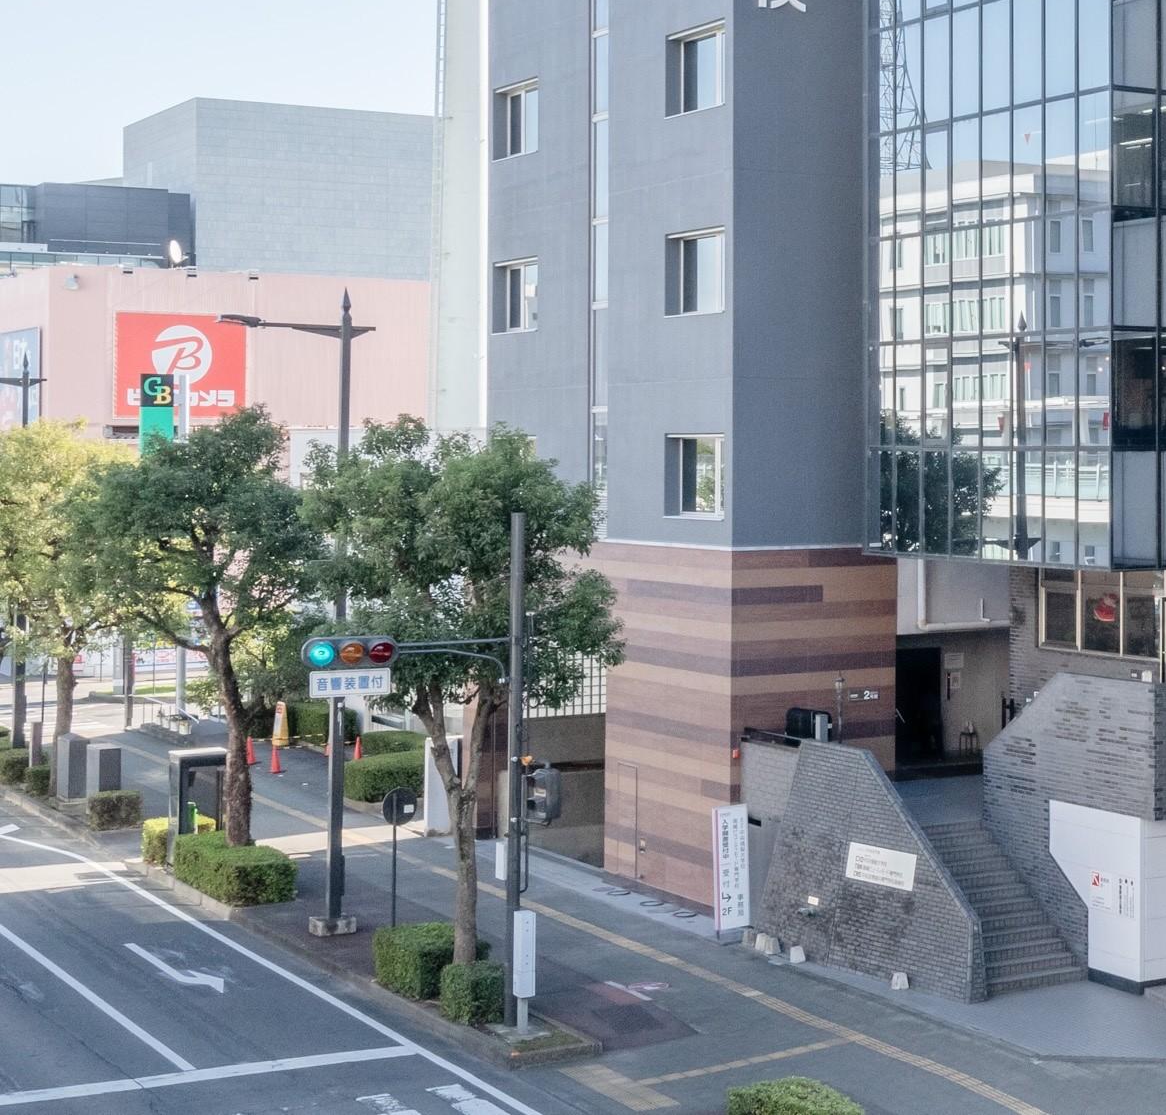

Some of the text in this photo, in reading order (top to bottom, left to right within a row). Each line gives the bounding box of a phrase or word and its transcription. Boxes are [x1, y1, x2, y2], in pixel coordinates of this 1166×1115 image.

[143, 376, 172, 405] GB
[316, 675, 383, 691] 音響装置付
[722, 907, 732, 916] 2F
